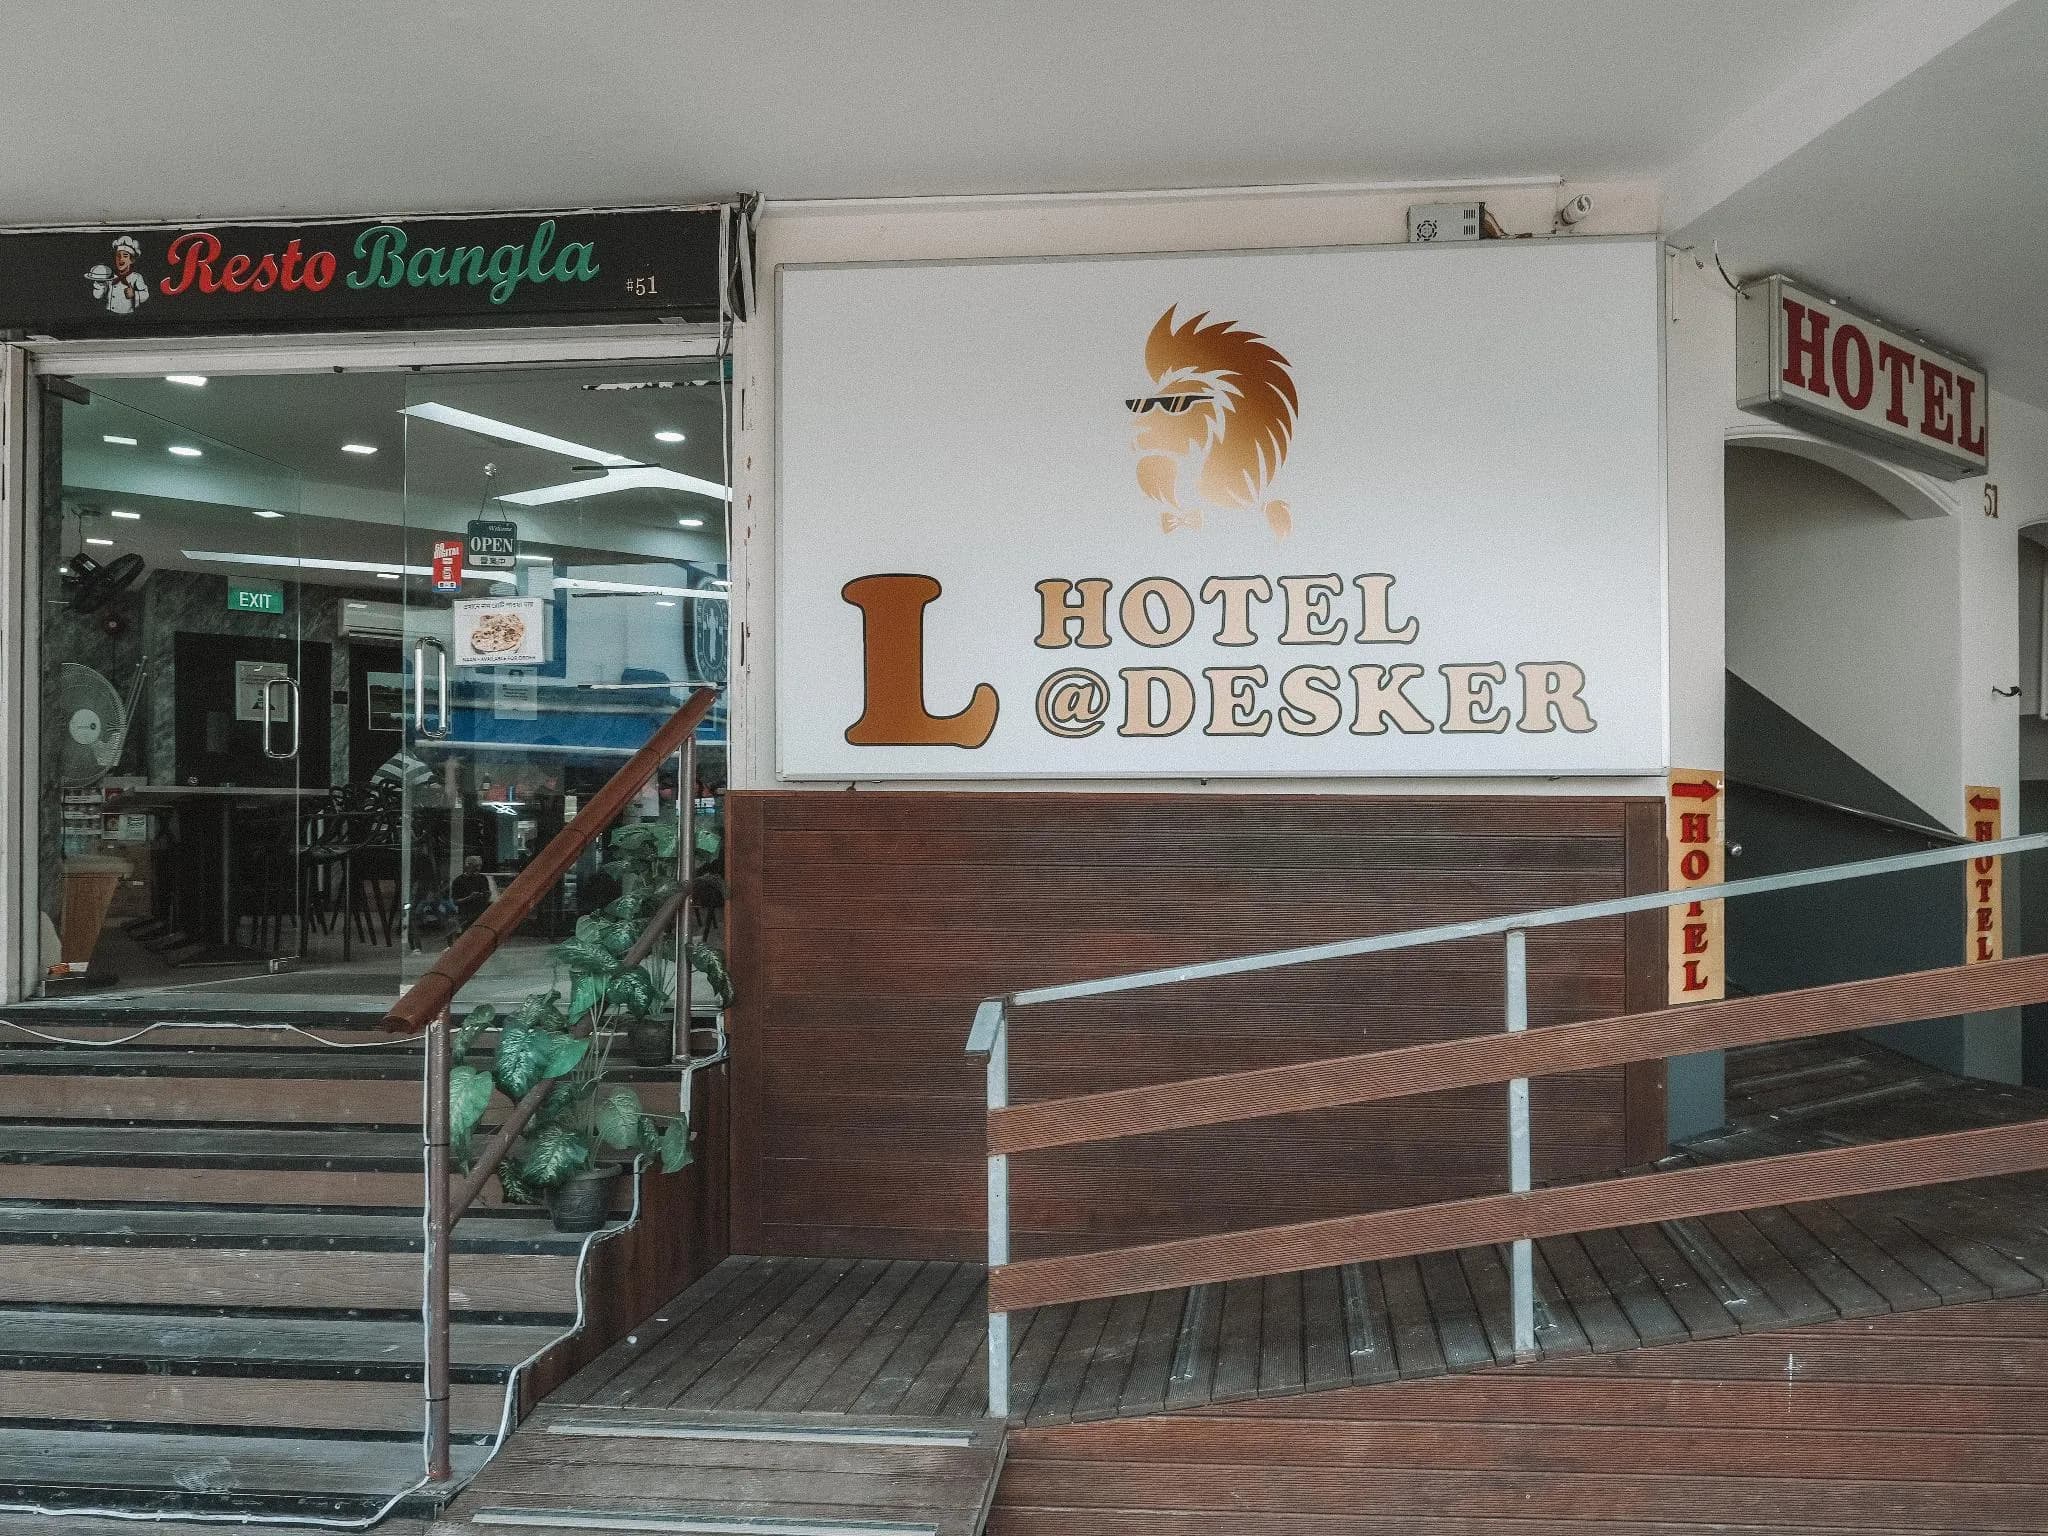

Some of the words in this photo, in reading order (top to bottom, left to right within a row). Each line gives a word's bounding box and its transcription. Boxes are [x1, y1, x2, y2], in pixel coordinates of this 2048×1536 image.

[161, 231, 336, 294] Resto
[346, 219, 600, 305] Bangla
[625, 275, 658, 296] #51
[1782, 296, 1985, 457] HOTEL
[1983, 482, 2000, 519] 51
[470, 536, 514, 553] OPEN
[238, 591, 273, 609] EXIT
[1033, 573, 1420, 649] HOTEL
[841, 573, 999, 750] L
[1033, 660, 1598, 739] @DESKER
